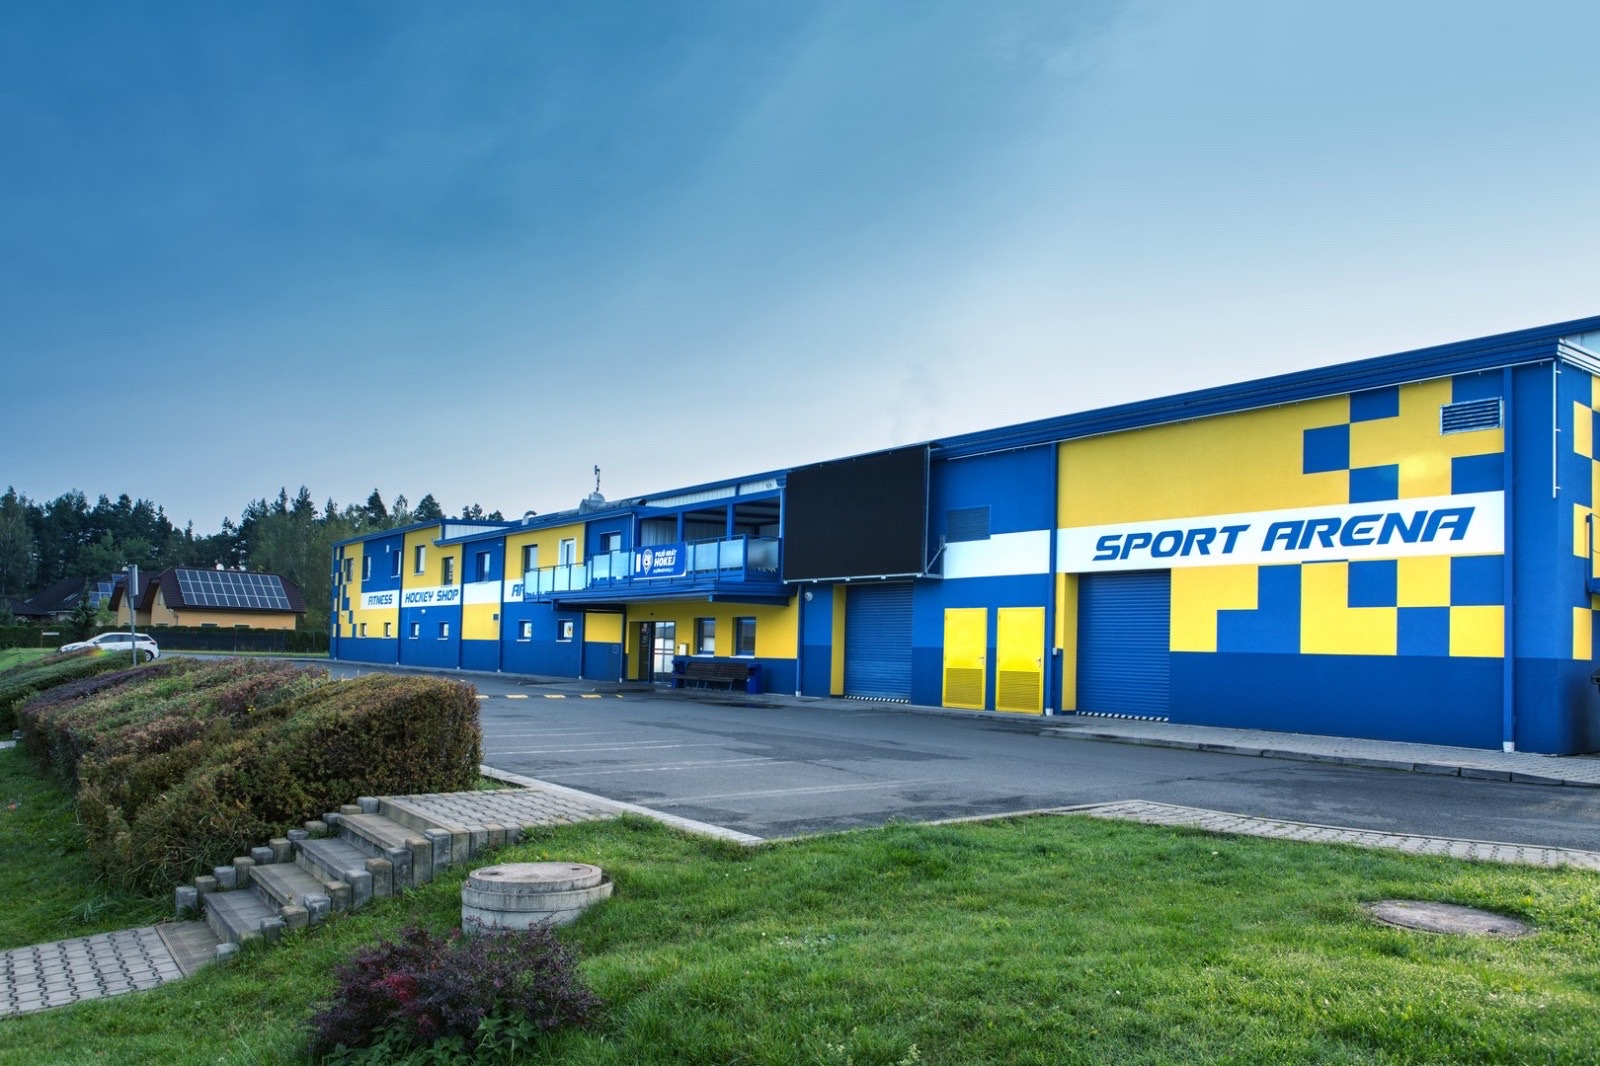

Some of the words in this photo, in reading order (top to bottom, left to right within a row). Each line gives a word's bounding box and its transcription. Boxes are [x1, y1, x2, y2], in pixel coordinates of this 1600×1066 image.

[1092, 524, 1251, 561] SPORT
[1261, 506, 1476, 552] ARENA
[654, 556, 676, 567] HOKEJ
[368, 594, 393, 605] FITNESS
[405, 591, 434, 603] HOCKEY
[436, 589, 459, 602] SHOP
